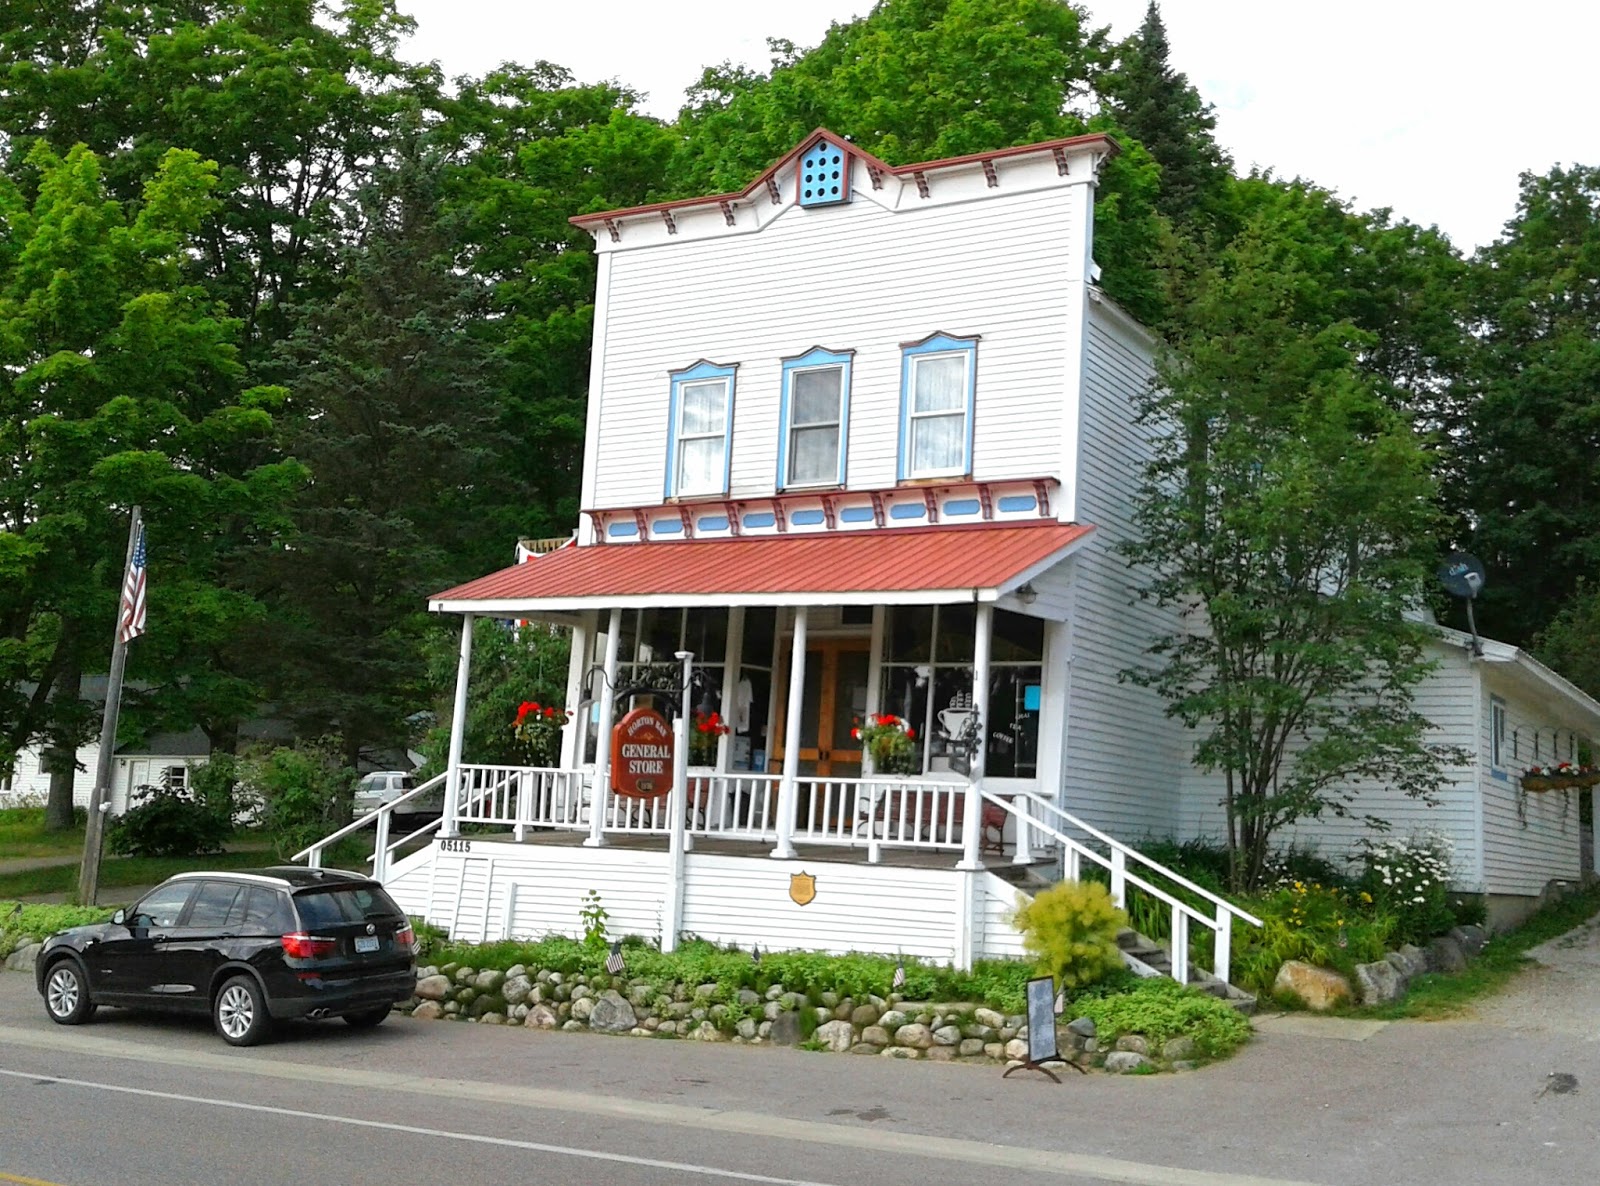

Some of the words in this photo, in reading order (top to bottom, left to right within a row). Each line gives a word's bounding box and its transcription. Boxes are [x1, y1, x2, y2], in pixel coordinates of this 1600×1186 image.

[627, 716, 655, 737] HORTON
[621, 743, 671, 759] GENERAL
[628, 760, 664, 775] STORE
[440, 840, 471, 853] 05115
